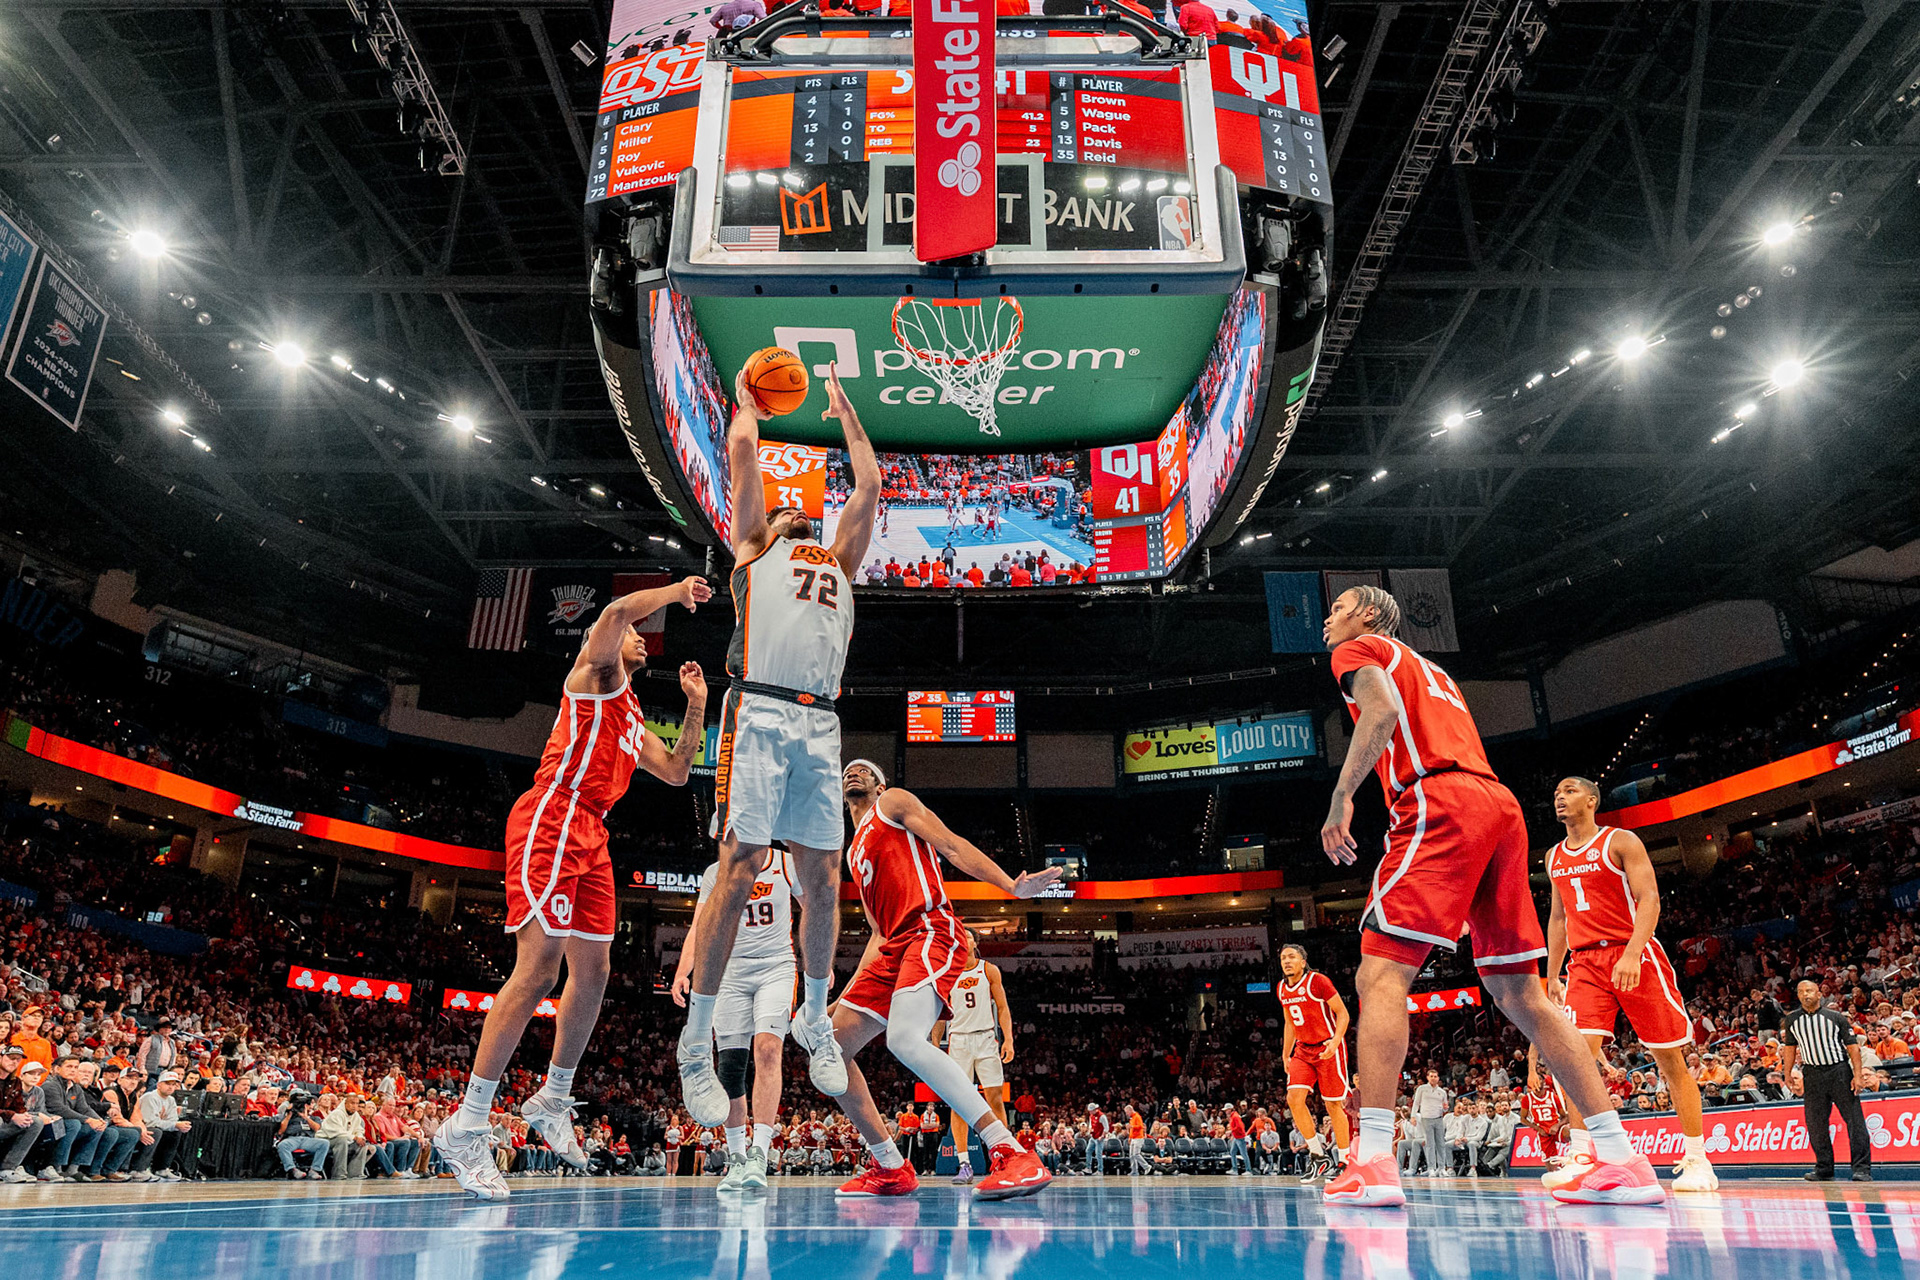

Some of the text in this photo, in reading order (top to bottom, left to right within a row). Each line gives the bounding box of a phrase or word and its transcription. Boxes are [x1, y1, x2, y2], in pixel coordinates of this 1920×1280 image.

[805, 76, 857, 88] PTS FLS
[1081, 78, 1123, 92] PLAYER
[807, 93, 853, 105] 4 2
[1061, 92, 1126, 107] 1 Brown
[622, 102, 660, 121] PLAYER
[807, 107, 851, 119] 7 1
[1021, 113, 1045, 121] 41.2
[1060, 106, 1131, 121] 5 Wague
[1267, 107, 1315, 127] PTS FLS
[603, 122, 653, 141] 1 Clary
[803, 121, 852, 133] 13 0
[869, 125, 886, 133] TO
[1060, 121, 1117, 134] 9 Pack
[1272, 124, 1313, 141] 7 0
[600, 135, 653, 155] 5 Miller
[805, 136, 852, 148] 4 0
[868, 138, 893, 146] REB
[1025, 139, 1041, 147] 23
[1058, 135, 1123, 149] 13 Davis
[1274, 137, 1313, 154] 4 1
[598, 152, 641, 169] 9 Roy
[805, 150, 849, 163] 2 1
[1057, 150, 1075, 160] 35
[1084, 151, 1117, 163] Reid
[1273, 150, 1315, 168] 13 1
[593, 160, 665, 184] 19 Vukovic
[1277, 165, 1318, 183] 0 0
[590, 187, 605, 199] 72
[1280, 179, 1320, 196] 5 0
[1165, 240, 1182, 250] NBA
[48, 271, 99, 327] OKLAHOMA CITY
[55, 295, 86, 333] THUNDER
[34, 336, 79, 378] 2024-2025
[44, 357, 62, 378] NBA
[25, 354, 75, 399] CHAMPIONS
[1168, 461, 1181, 497] 35
[1114, 486, 1140, 514] 41
[789, 545, 838, 567] OSU
[551, 585, 596, 602] THUNDER
[793, 568, 838, 610] 72
[144, 665, 172, 686] 312
[926, 693, 942, 703] 35
[981, 693, 995, 703] 41
[326, 718, 347, 735] 313
[1846, 722, 1898, 748] PRESENTED BY
[1221, 723, 1310, 759] LOUD CITY
[717, 732, 733, 803] COWBOYS
[1137, 759, 1304, 782] BRING THE THUNDER EXIT NOW
[247, 800, 294, 818] PRESENTED BY
[1552, 862, 1601, 878] OKLAHOMA
[658, 885, 697, 894] BASKETBALL
[750, 881, 774, 901] SU
[1570, 877, 1591, 912] 1
[551, 894, 573, 925] OU
[1895, 895, 1911, 908] 114
[70, 912, 89, 930] 108
[745, 902, 775, 927] 19
[1133, 936, 1257, 953] POST OAK PARTY TERRACE
[957, 976, 979, 990] OSU
[964, 992, 976, 1009] 9
[1037, 1003, 1126, 1015] THUNDER
[1289, 1005, 1305, 1026] 9
[1536, 1108, 1553, 1121] 12
